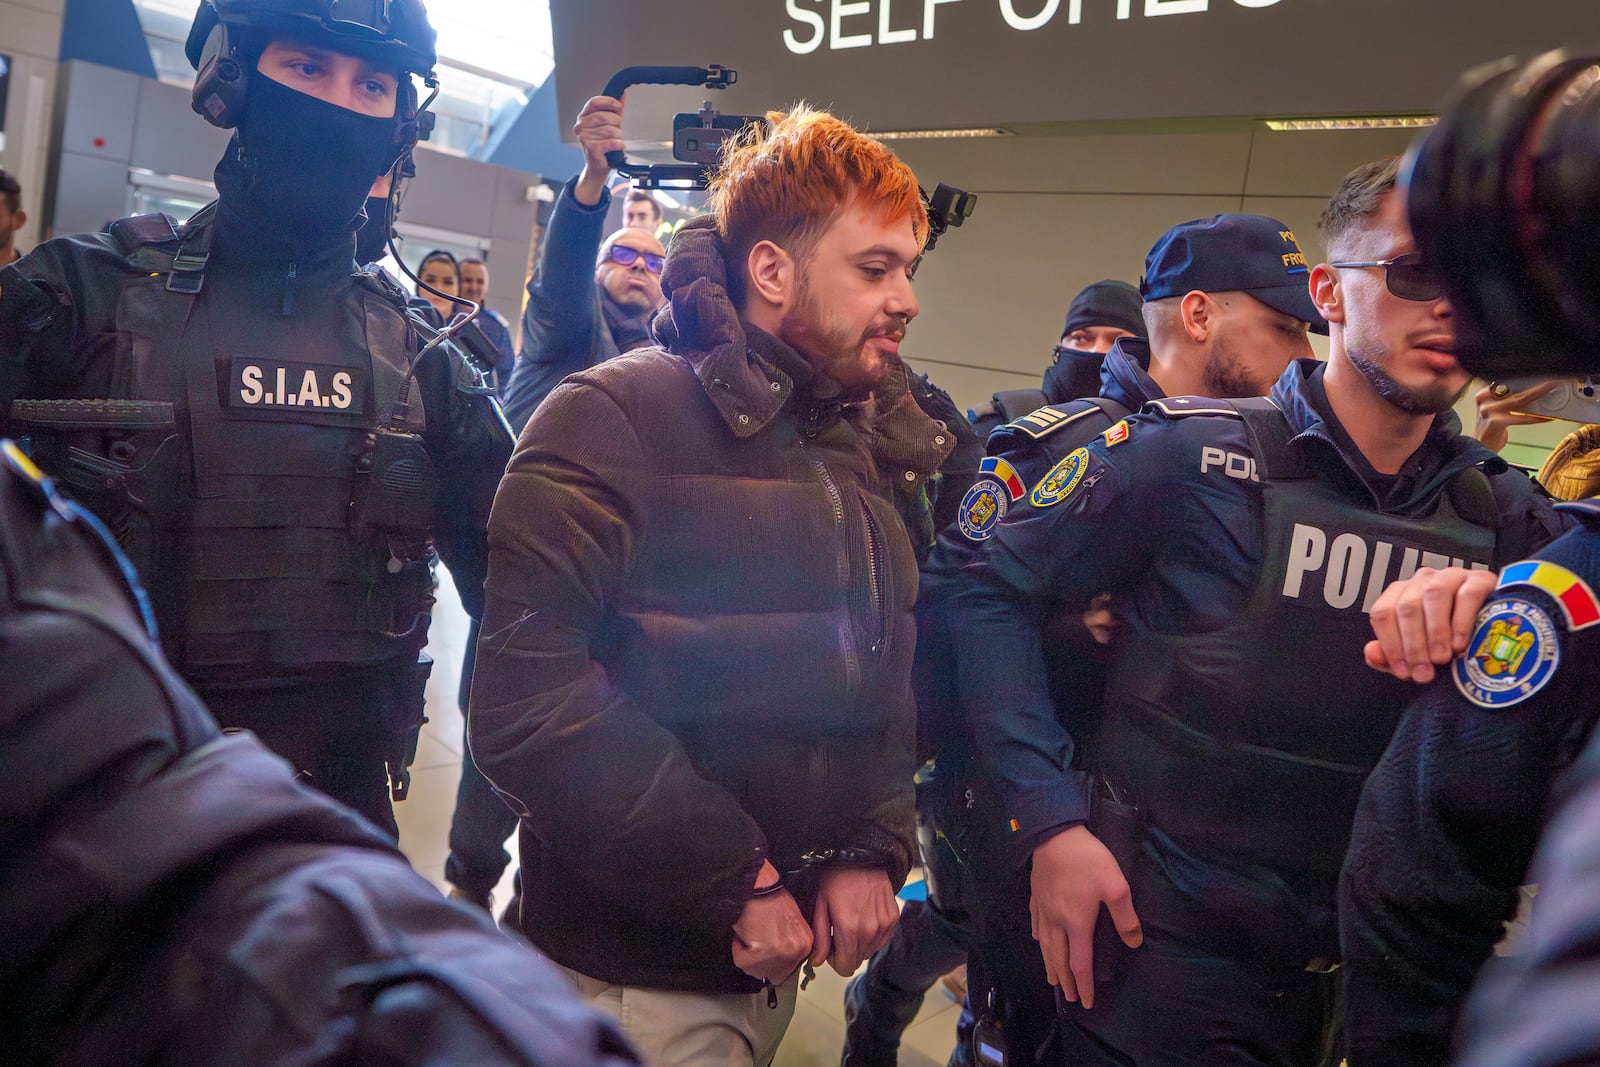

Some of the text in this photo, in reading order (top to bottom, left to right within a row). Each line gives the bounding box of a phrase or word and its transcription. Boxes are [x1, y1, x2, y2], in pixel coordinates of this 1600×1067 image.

[783, 0, 962, 55] SELF
[1281, 252, 1307, 267] FRO
[240, 365, 352, 409] S.I.A.S
